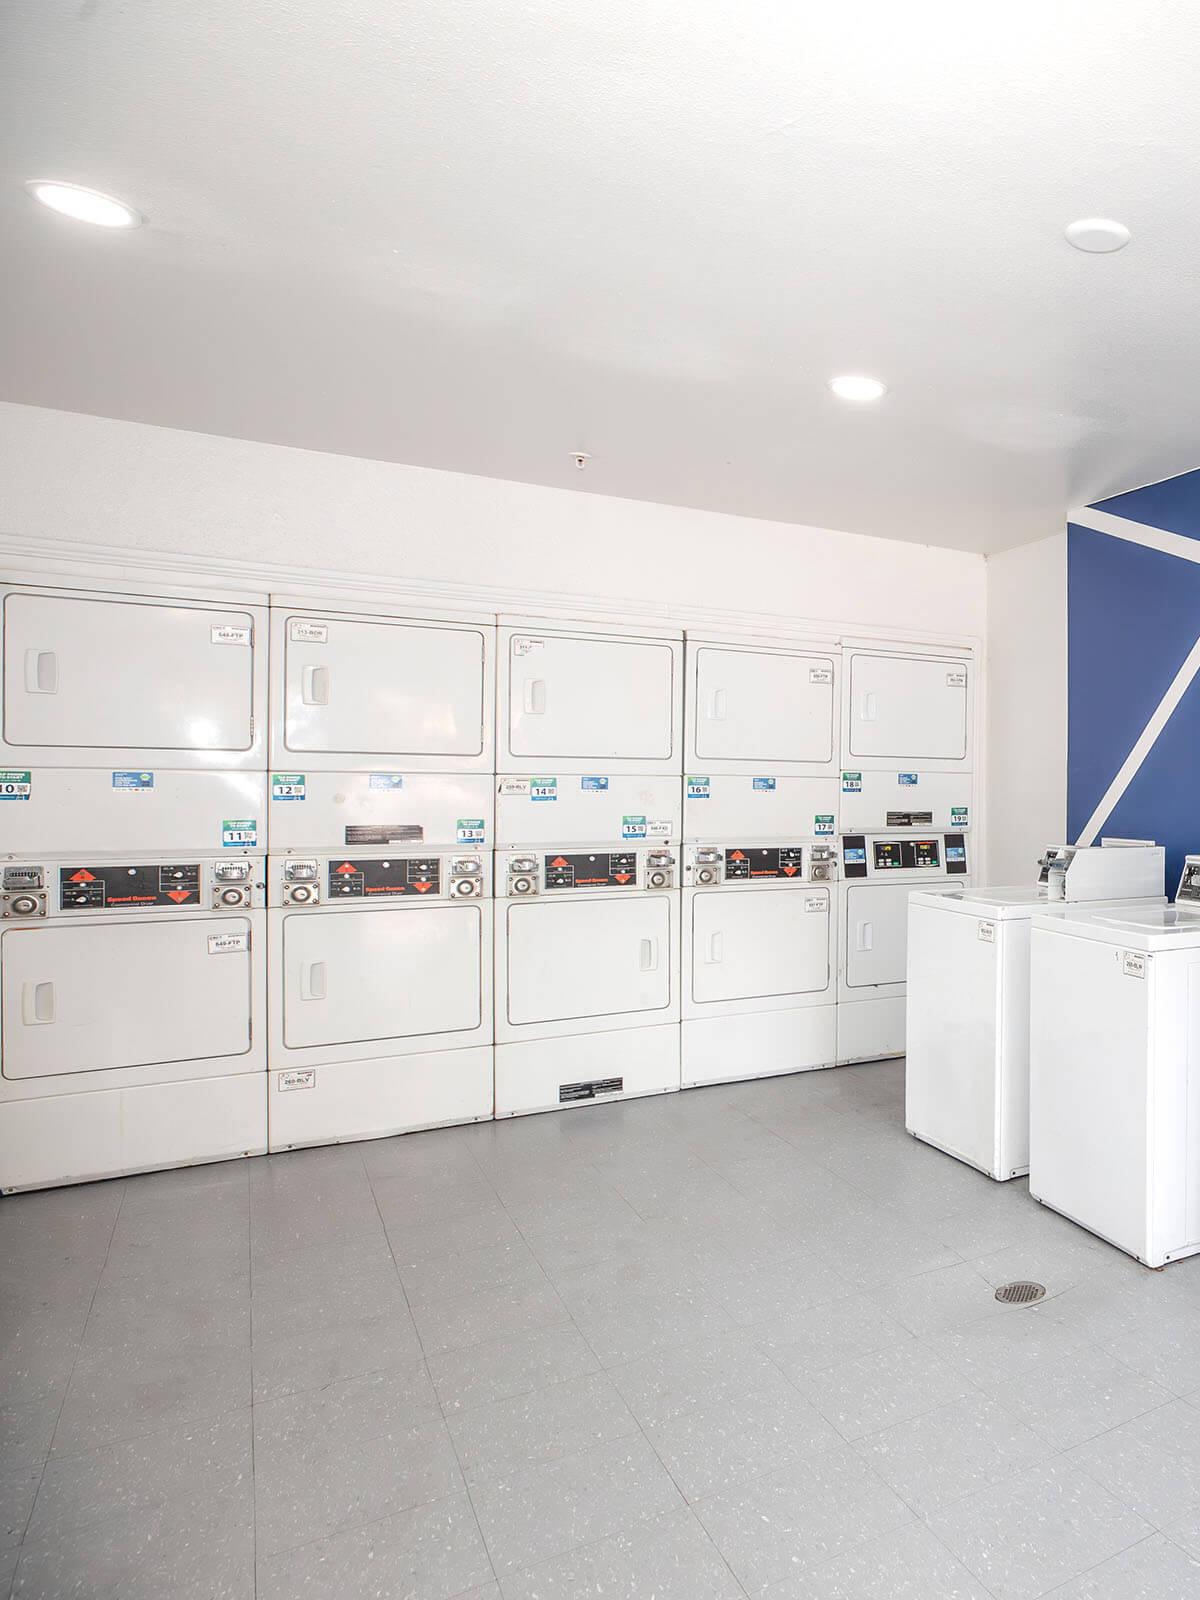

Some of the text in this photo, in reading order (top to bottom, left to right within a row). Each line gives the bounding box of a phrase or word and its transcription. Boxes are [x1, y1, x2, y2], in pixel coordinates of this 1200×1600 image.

[626, 825, 637, 833] 15
[229, 832, 242, 840] 11
[461, 830, 473, 838] 13
